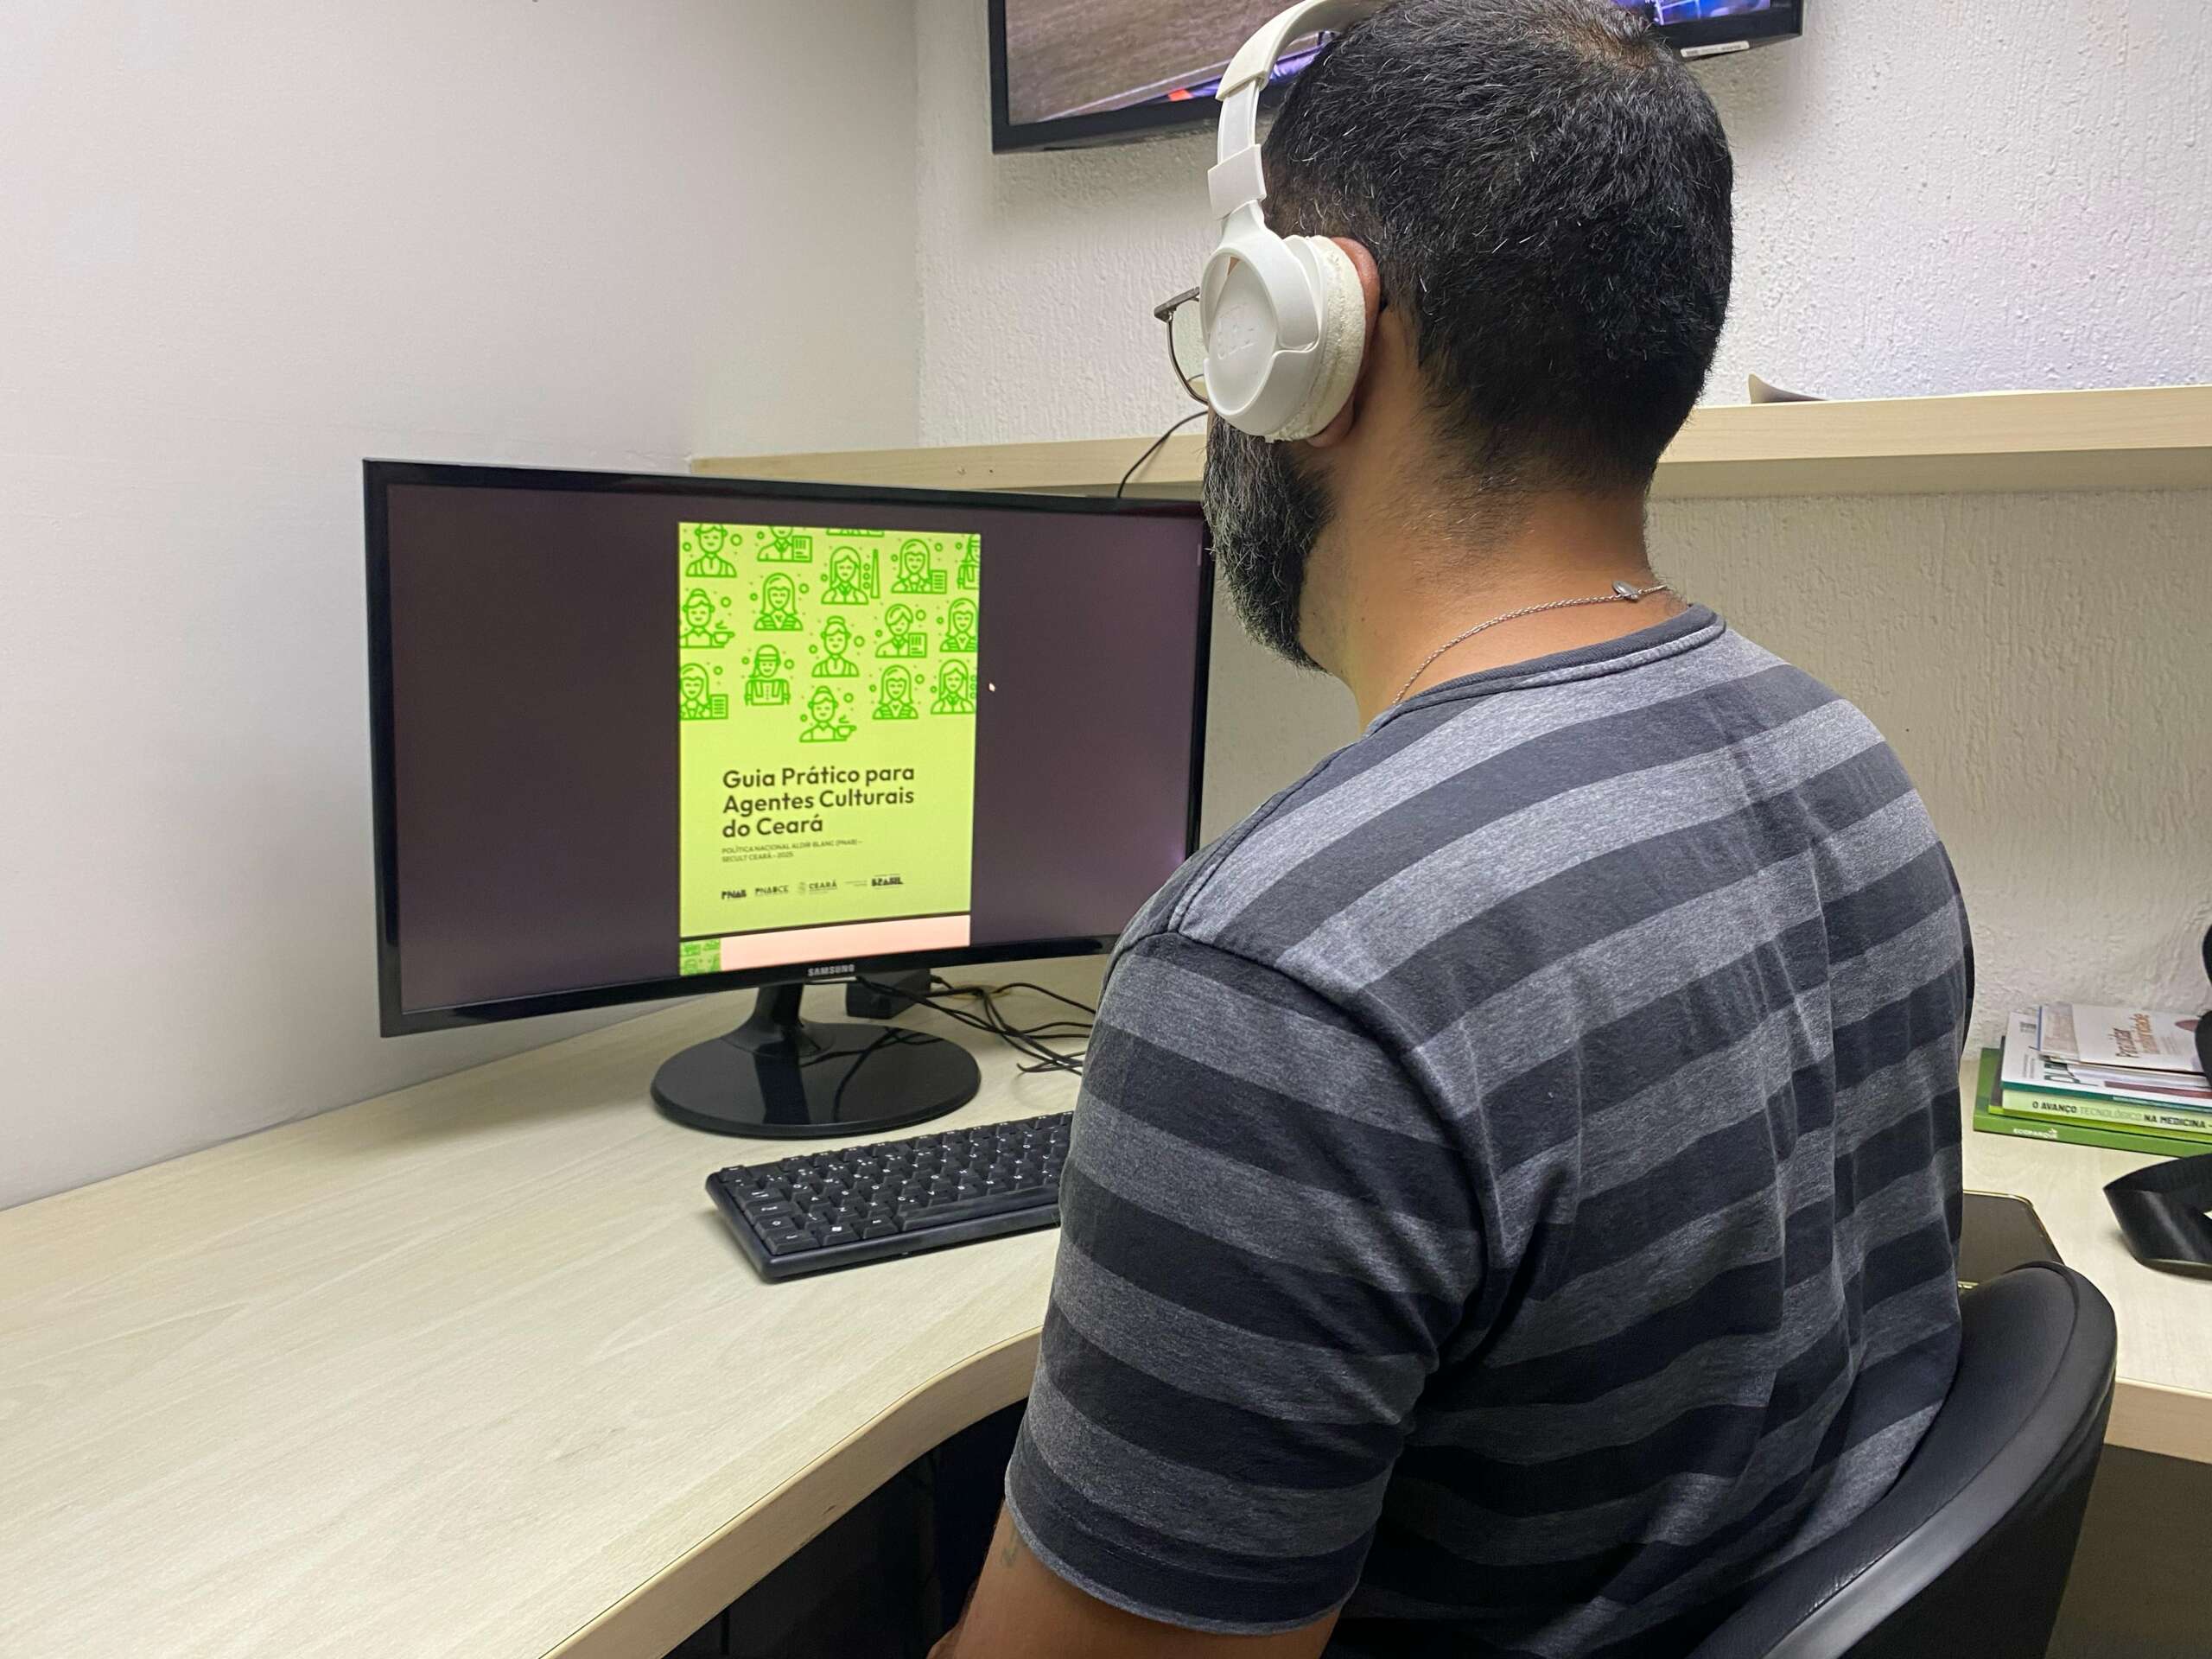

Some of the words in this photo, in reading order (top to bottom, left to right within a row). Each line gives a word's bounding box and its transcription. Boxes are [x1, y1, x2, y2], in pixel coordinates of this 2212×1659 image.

[722, 769, 776, 789] Guia
[781, 766, 861, 786] Prático
[865, 767, 915, 787] para
[722, 792, 815, 818] Agentes
[818, 786, 915, 808] Culturais
[722, 819, 751, 838] do
[756, 814, 823, 836] Ceará
[721, 845, 753, 854] POLÍTICA
[721, 854, 747, 862] SECULT
[748, 852, 772, 861] CEARÁ
[809, 880, 837, 888] CEARÁ
[807, 963, 855, 976] SAMSUNG
[2041, 1102, 2078, 1115] AVANÇO
[2144, 1114, 2158, 1122] NA
[2159, 1116, 2207, 1128] MEDICINA
